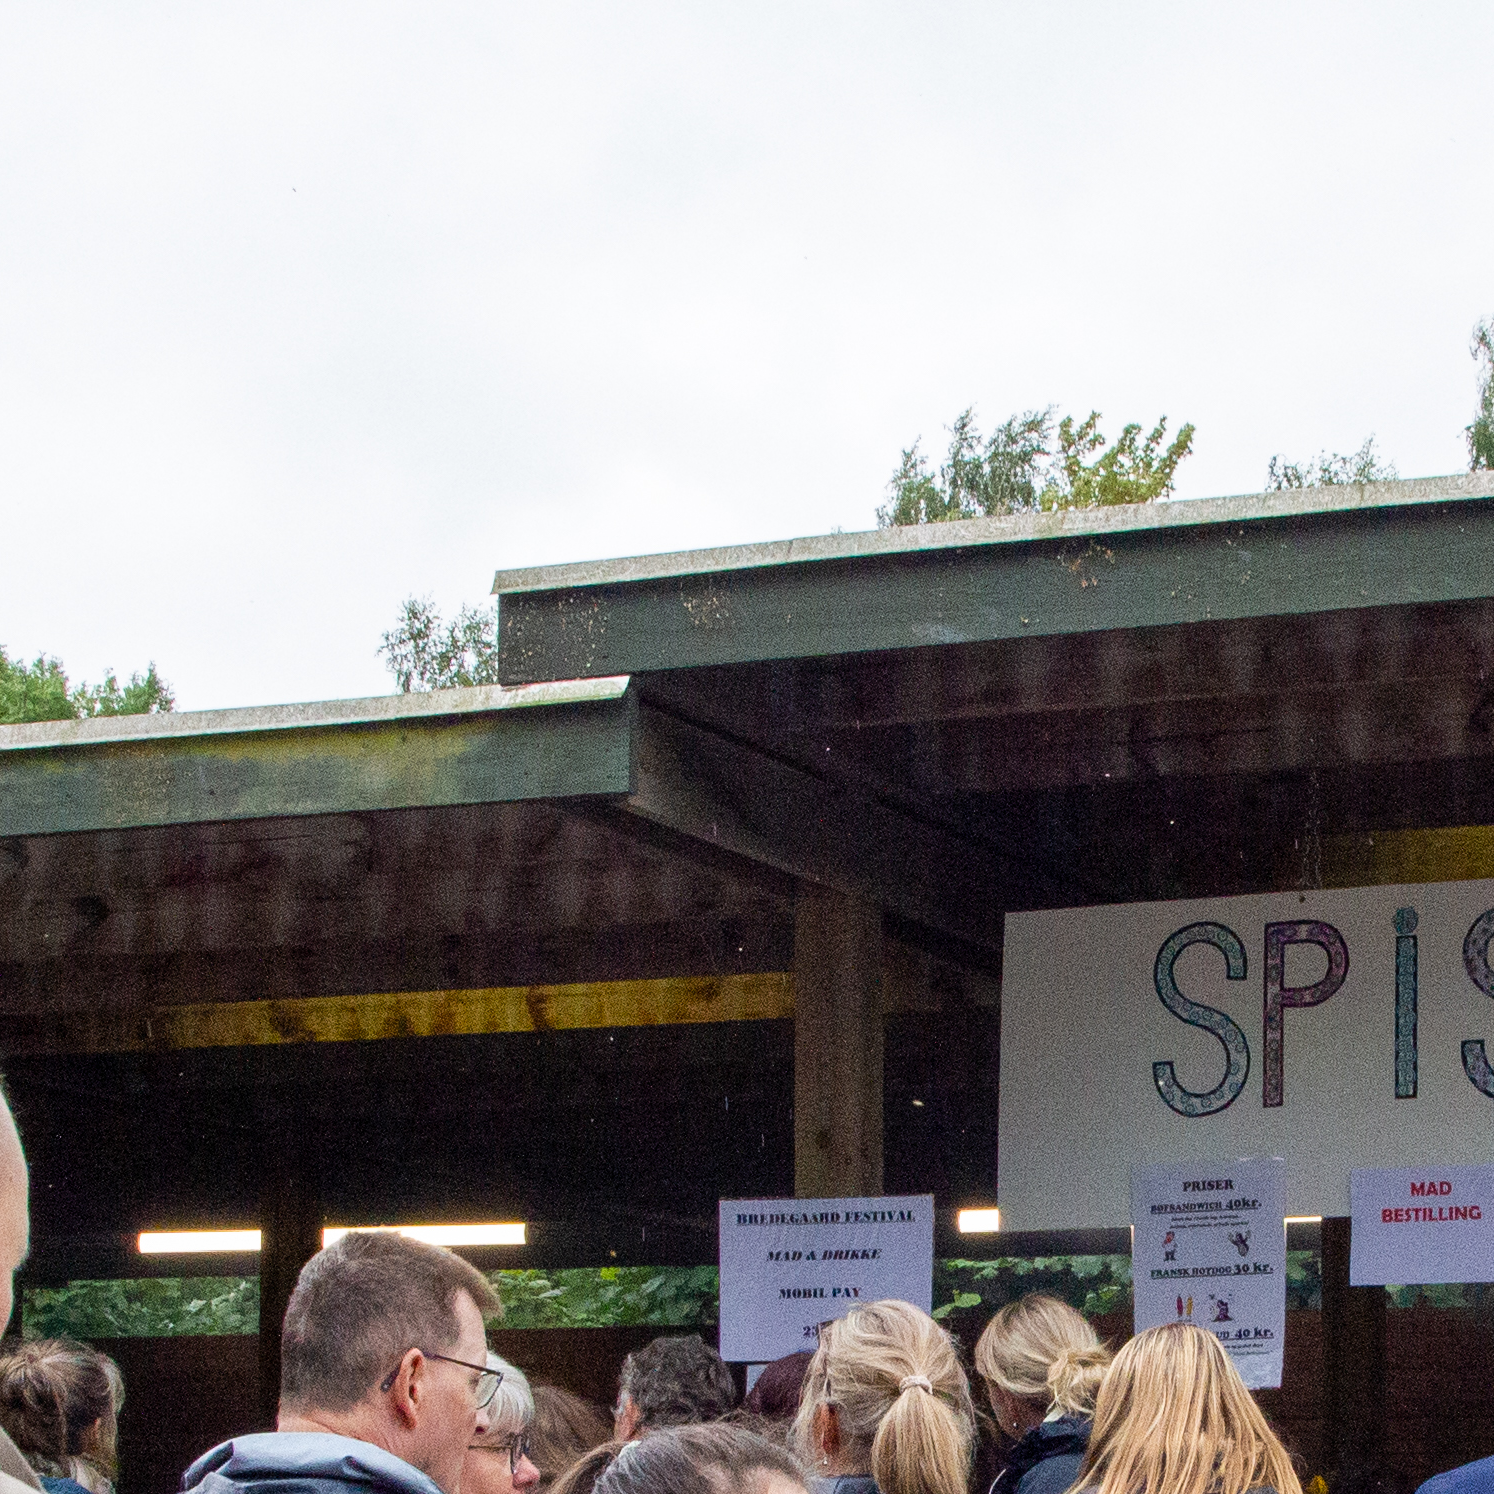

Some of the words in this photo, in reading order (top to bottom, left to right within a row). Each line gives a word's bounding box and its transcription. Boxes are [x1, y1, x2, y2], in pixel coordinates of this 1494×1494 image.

[1182, 1179, 1235, 1192] PRISER
[1410, 1181, 1452, 1196] MAD
[845, 1210, 916, 1223] FESTIVAL
[1381, 1205, 1482, 1223] BESTILLING
[766, 1250, 803, 1262] MAD
[821, 1248, 882, 1261] DRIKKE
[1151, 1267, 1190, 1278] FRANSK
[1191, 1267, 1232, 1277] HOTDOG
[1234, 1264, 1249, 1275] 30
[779, 1288, 827, 1300] MOBIL
[832, 1287, 861, 1298] PAY
[1235, 1328, 1250, 1339] 40
